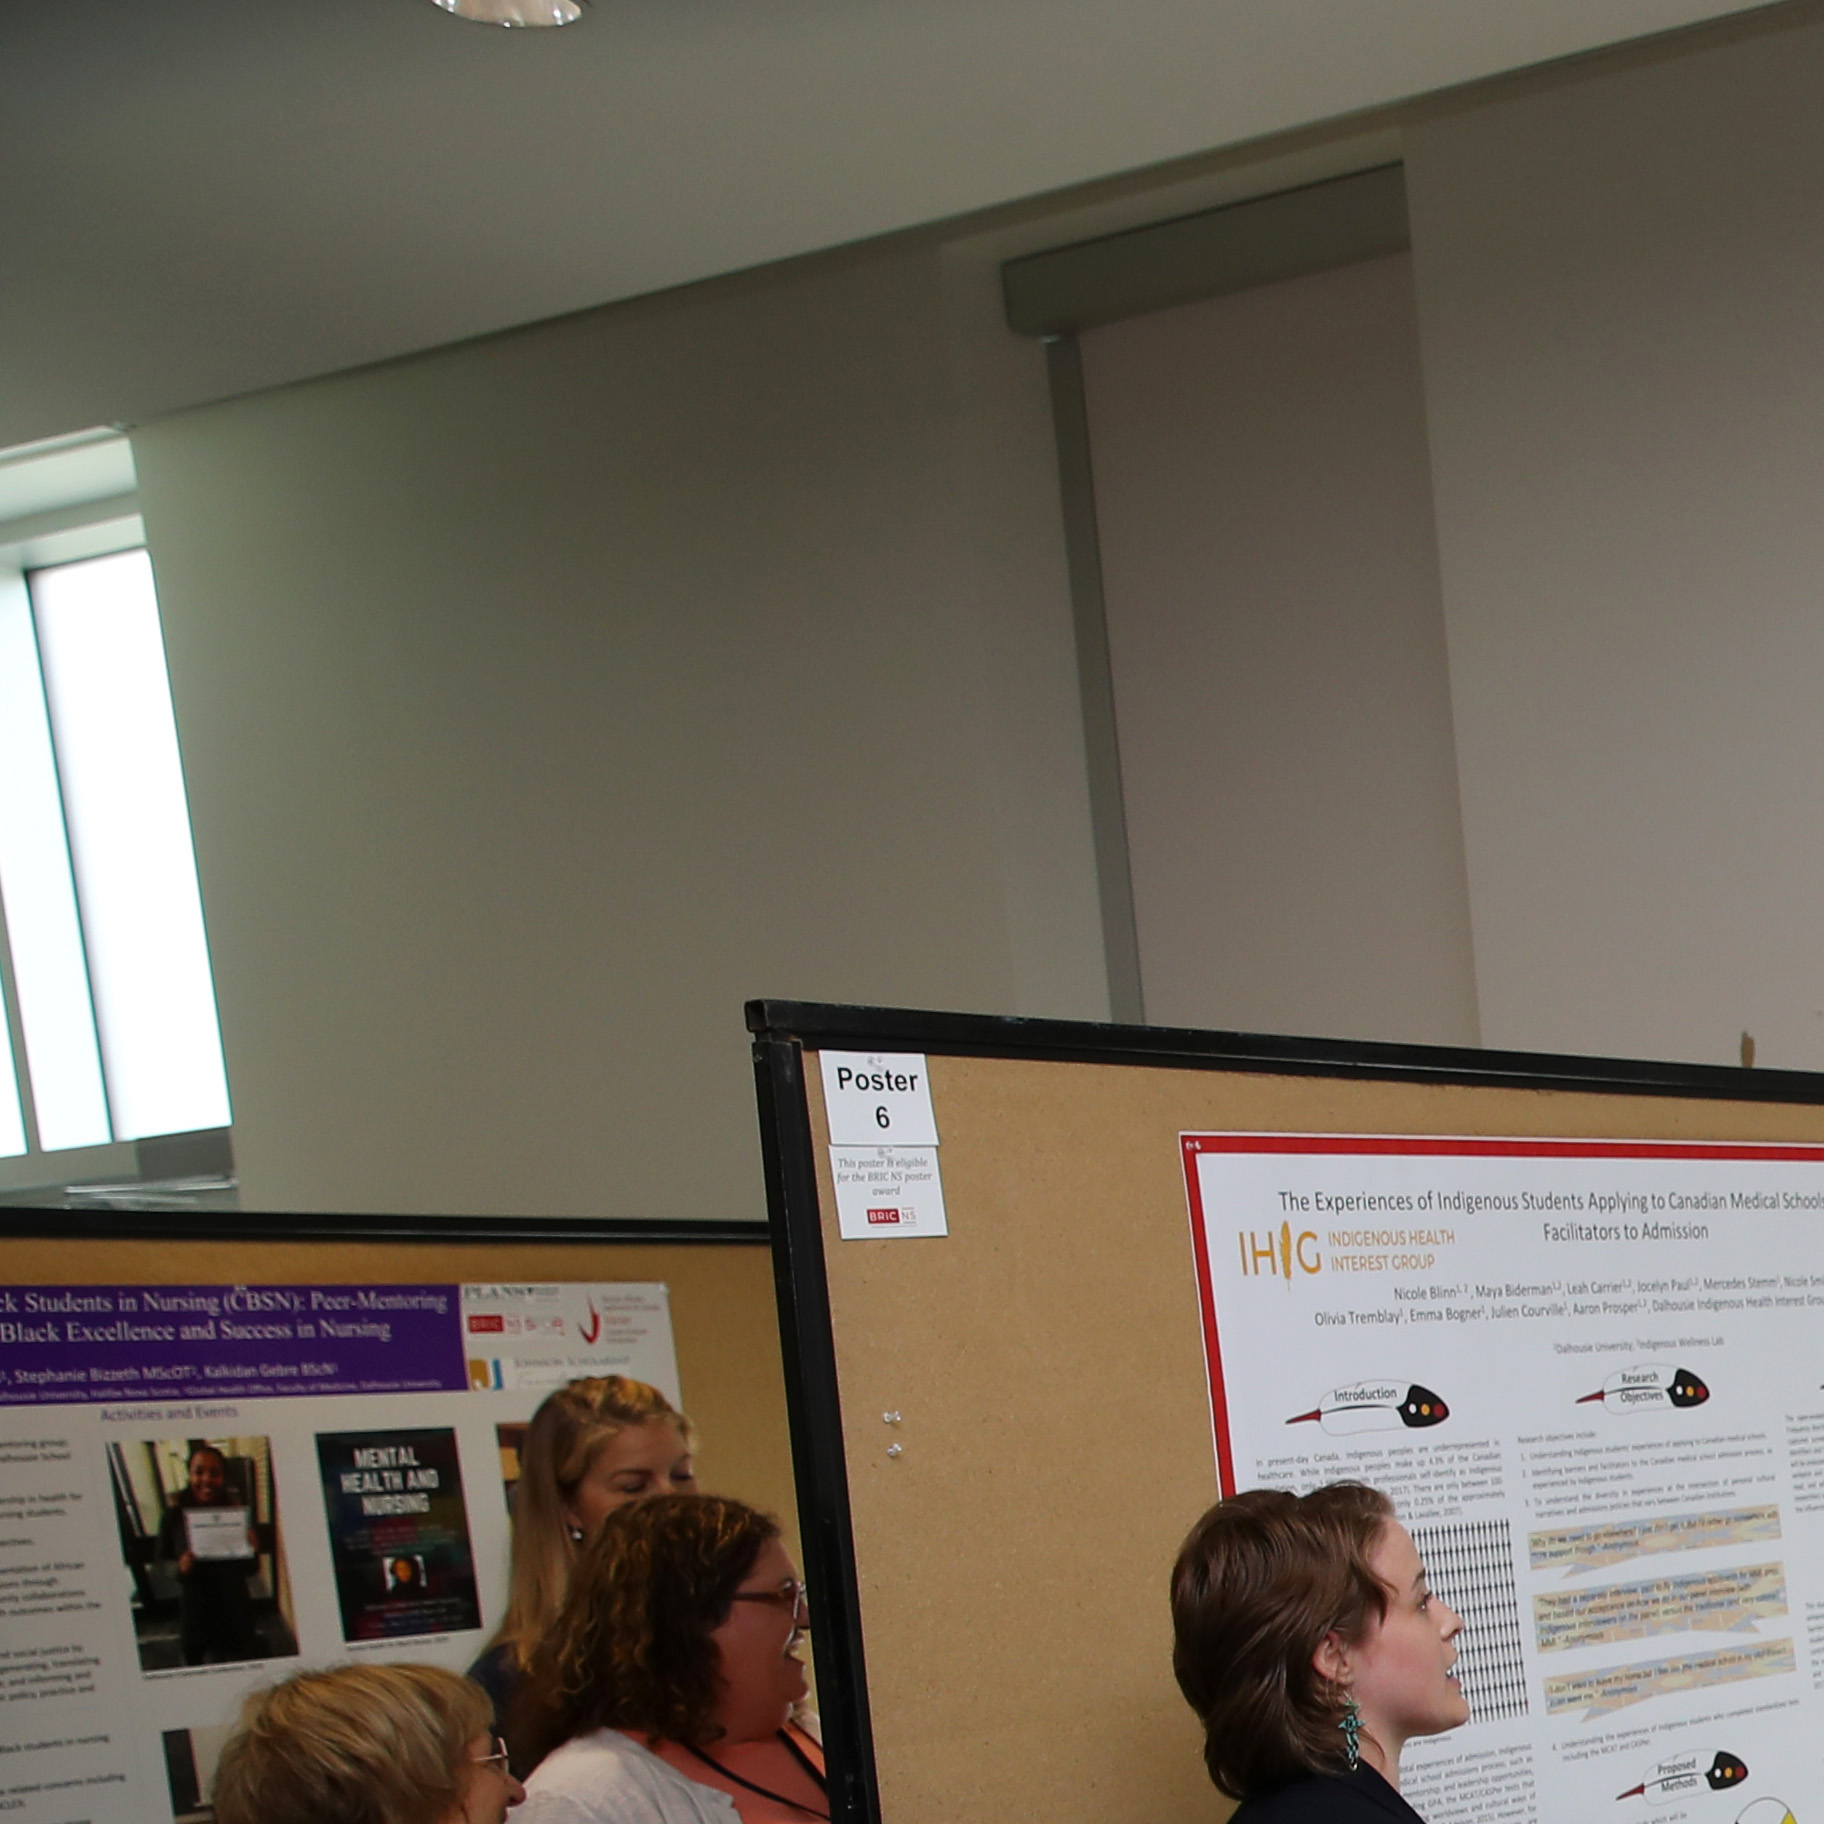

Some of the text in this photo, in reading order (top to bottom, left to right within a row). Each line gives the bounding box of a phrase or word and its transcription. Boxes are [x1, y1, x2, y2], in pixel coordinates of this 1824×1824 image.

[837, 1067, 918, 1091] Poster
[875, 1106, 890, 1128] 6
[838, 1158, 856, 1168] This
[858, 1159, 885, 1171] poster
[896, 1157, 928, 1169] eligible
[837, 1172, 932, 1184] for the BRIC NS poster
[872, 1186, 900, 1196] award
[1279, 1191, 1309, 1211] The
[1315, 1191, 1412, 1214] Experiences
[1417, 1191, 1432, 1209] of
[1438, 1192, 1518, 1214] Indigenous
[1521, 1192, 1583, 1209] Students
[1588, 1192, 1647, 1213] Applying
[1651, 1194, 1665, 1209] to
[1668, 1192, 1726, 1209] Canadian
[1730, 1192, 1779, 1209] Medical
[869, 1210, 916, 1222] BRIC NS
[1328, 1229, 1456, 1247] INDIGENOUS HEALTH
[1544, 1221, 1708, 1240] Facilitators to Admission
[1331, 1254, 1435, 1272] INTEREST GROUP
[1394, 1286, 1426, 1300] Nicole
[1475, 1284, 1502, 1299] Maya
[1637, 1280, 1668, 1293] Jocelyn
[1703, 1277, 1745, 1289] Mercedes
[1783, 1276, 1808, 1287] Nicole
[24, 1291, 113, 1313] Students
[118, 1291, 138, 1312] in
[143, 1290, 220, 1316] Nursing
[223, 1290, 306, 1315] (CBSN):
[311, 1290, 448, 1314] Peer-Mentoring
[1314, 1311, 1345, 1325] Olivia
[1410, 1308, 1442, 1321] Emma
[1491, 1305, 1518, 1318] Julien
[1652, 1298, 1694, 1312] Dalhousie
[1697, 1297, 1743, 1312] Indigenous
[1746, 1296, 1773, 1307] Health
[0, 1319, 392, 1342] Black Excellence and Success in Nursing
[14, 1368, 88, 1386] Stephanie
[1621, 1372, 1659, 1384] Research
[1334, 1387, 1397, 1402] Introduction
[1620, 1390, 1663, 1404] Objectives
[101, 1405, 238, 1422] Activities and Events
[353, 1446, 420, 1468] MENTAL
[340, 1469, 440, 1493] HEALTH AND
[361, 1492, 430, 1516] NURSING
[1657, 1758, 1696, 1775] Proposed
[1661, 1777, 1698, 1792] Methods
